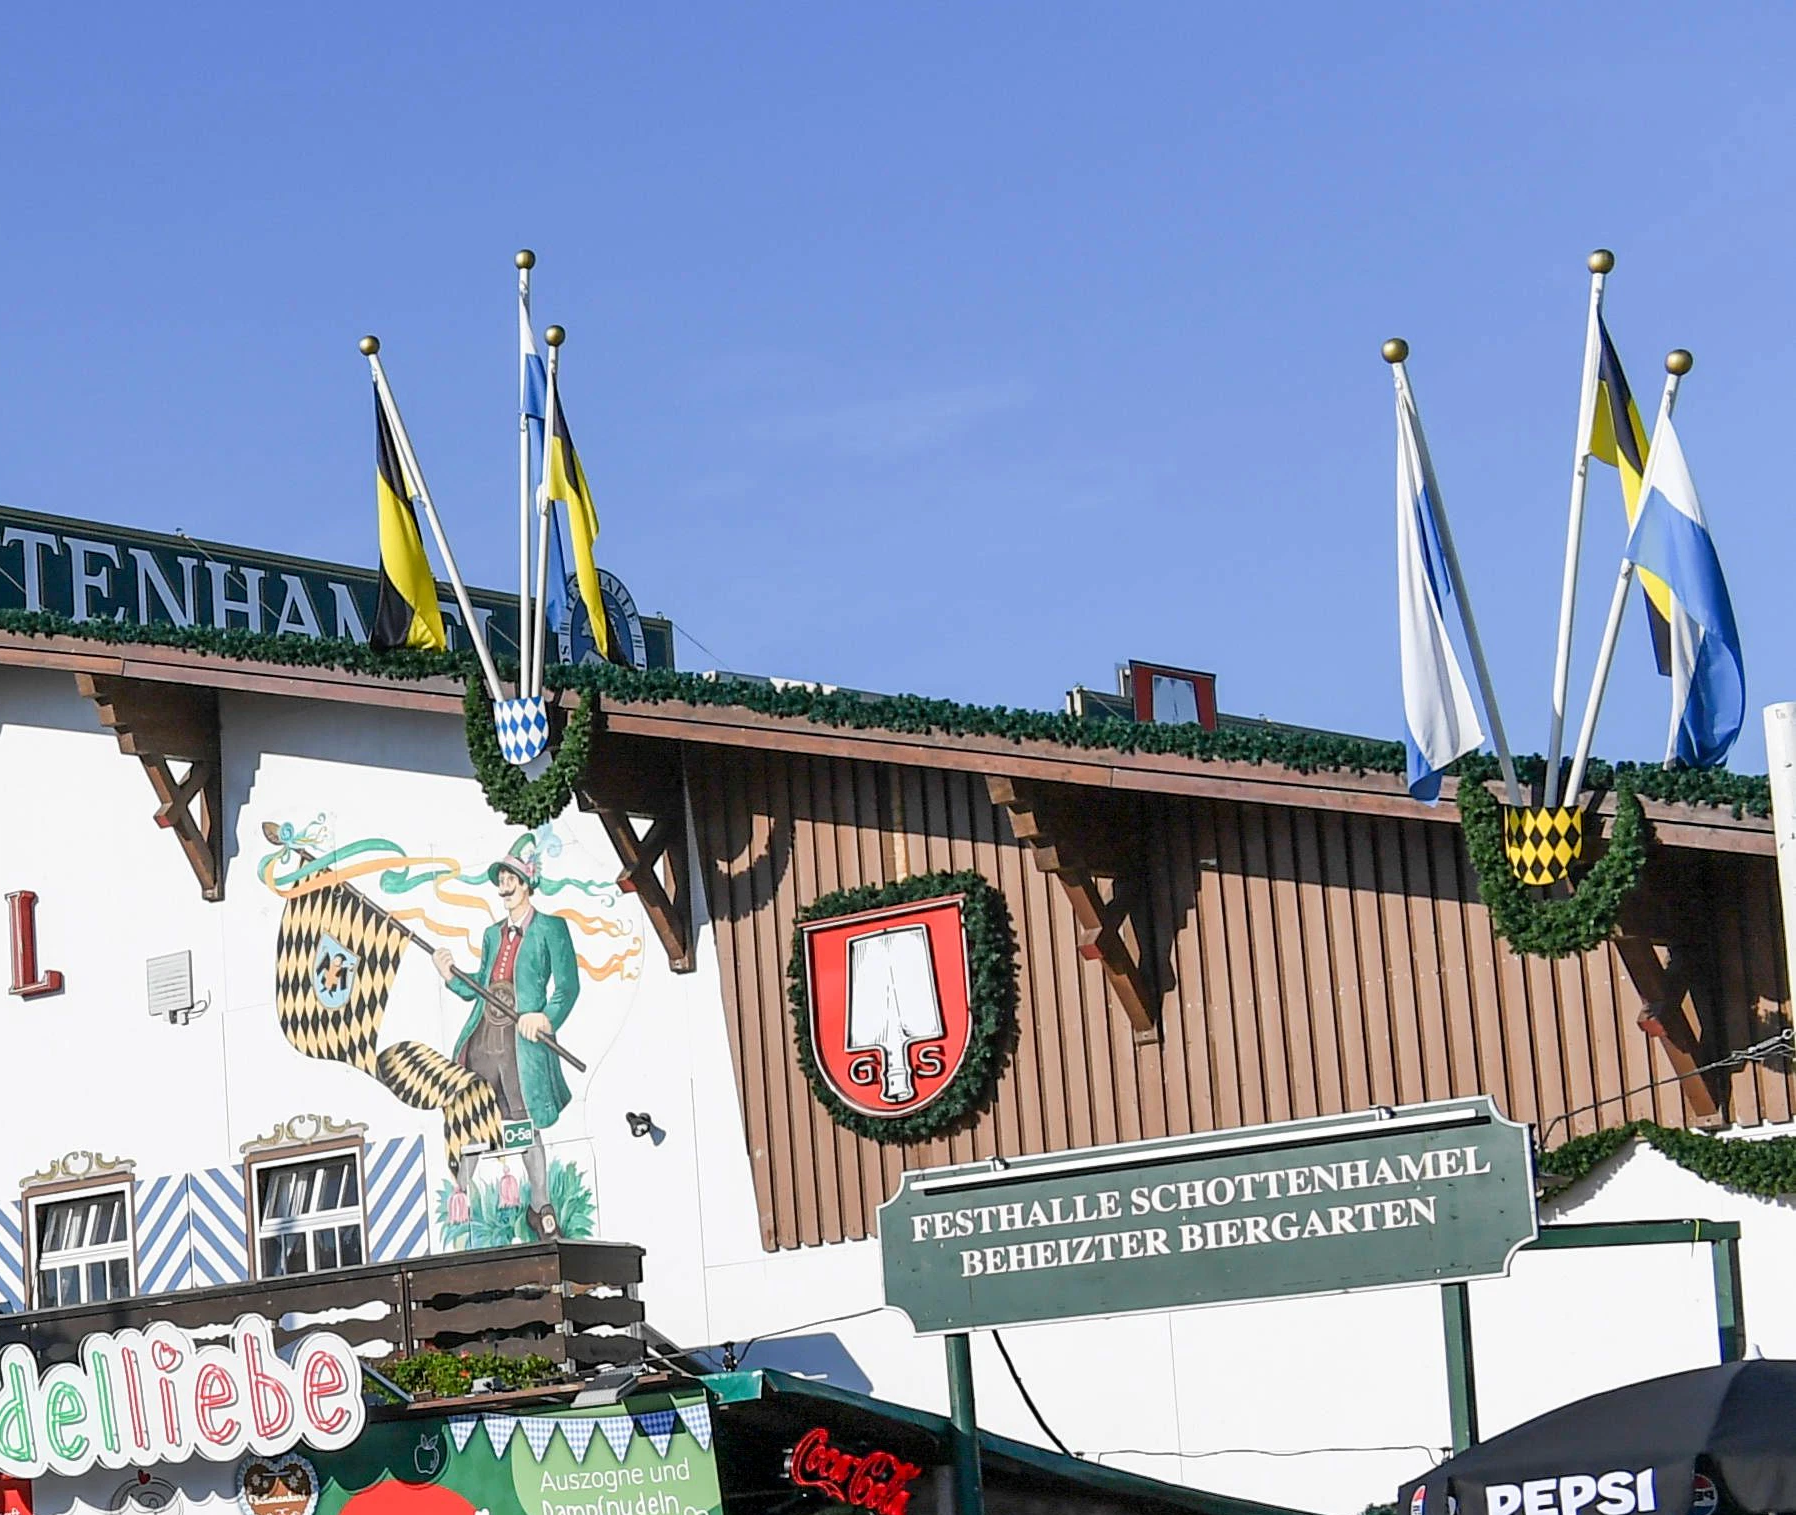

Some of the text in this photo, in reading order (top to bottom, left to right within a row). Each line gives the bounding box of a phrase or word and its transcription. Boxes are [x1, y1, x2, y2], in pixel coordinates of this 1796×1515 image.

[850, 1046, 943, 1085] G S
[911, 1146, 1491, 1243] FESTHALLE SCHOTTENHAMEL
[960, 1196, 1439, 1278] BEHEIZTER BIERGARTEN
[540, 1461, 691, 1496] Auszogne und
